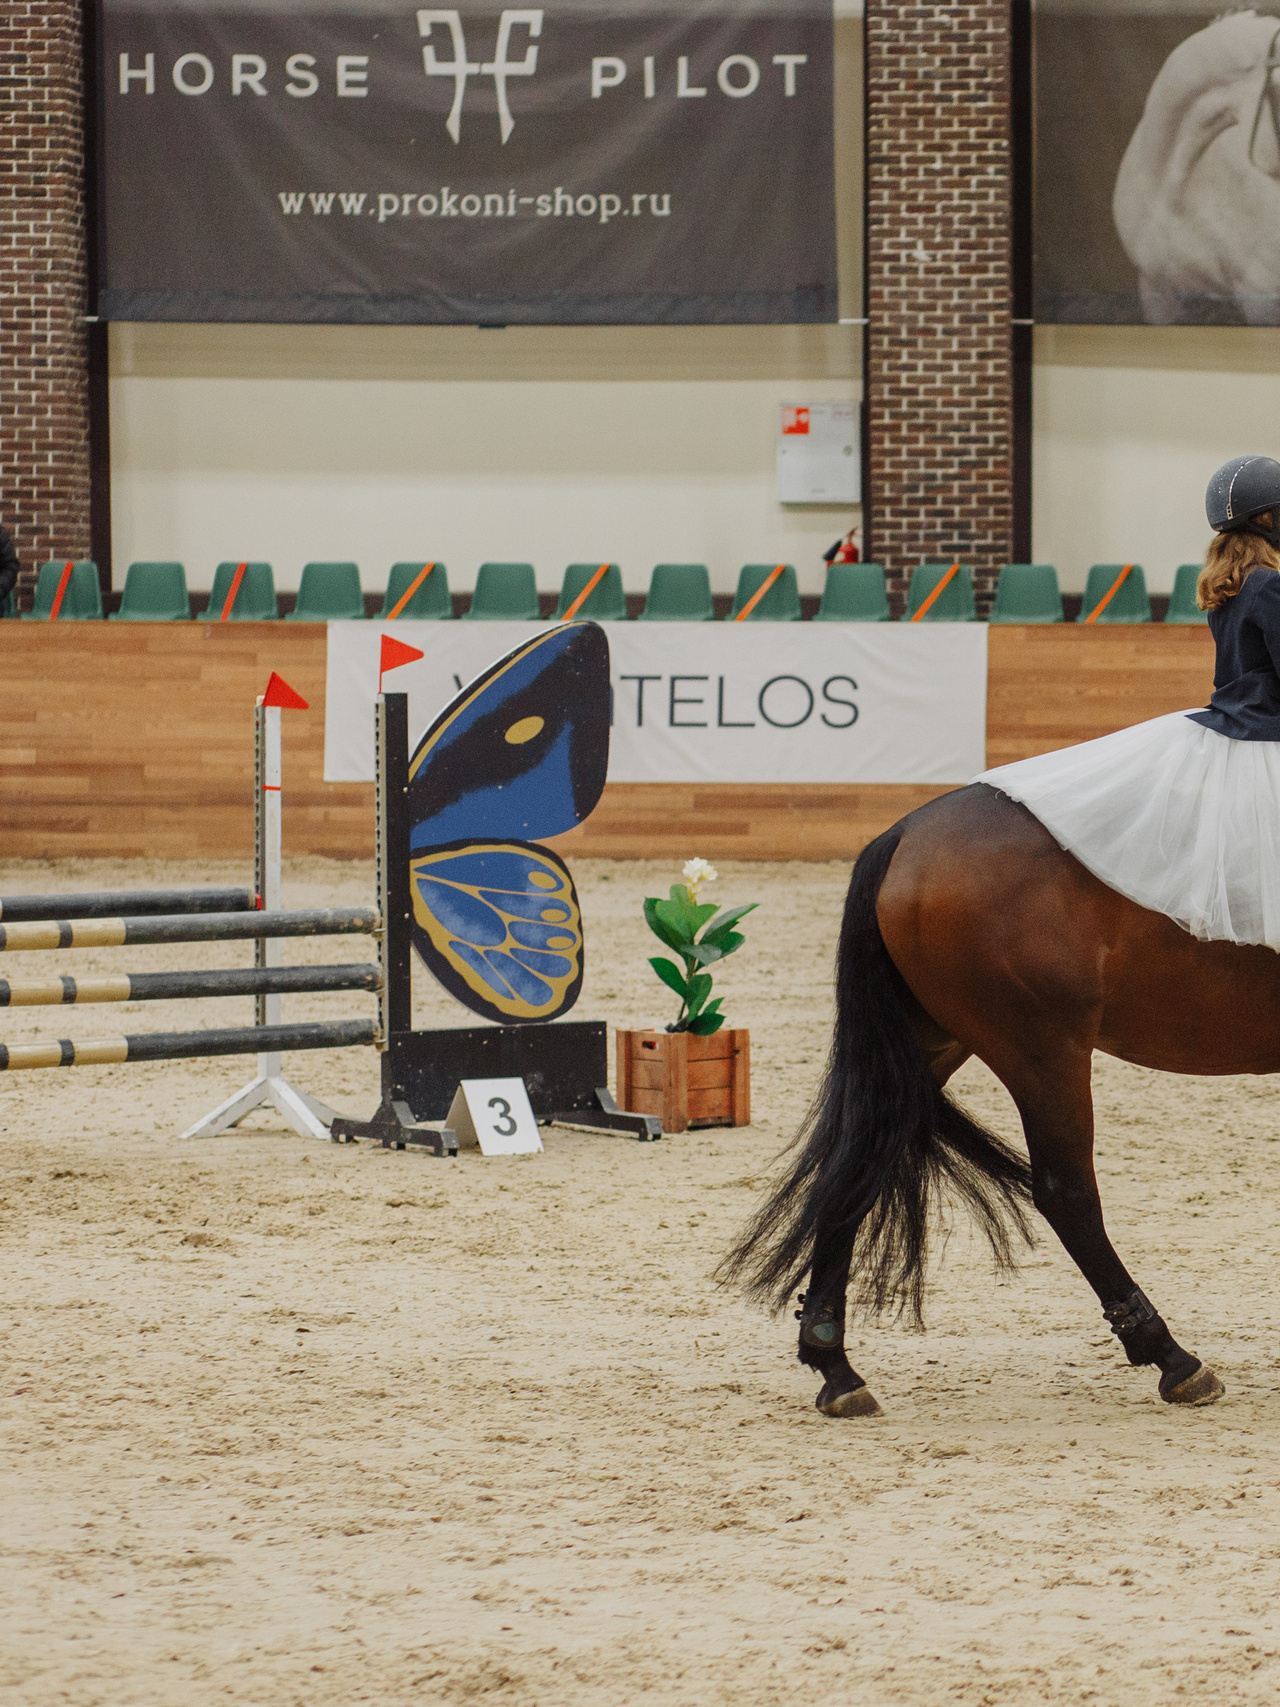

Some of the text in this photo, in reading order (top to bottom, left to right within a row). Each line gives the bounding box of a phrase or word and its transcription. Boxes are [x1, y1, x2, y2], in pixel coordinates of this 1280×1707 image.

[118, 52, 808, 99] HORSE PILOT
[278, 186, 672, 224] www.prokoni-shop.ru
[487, 1096, 518, 1137] 3
